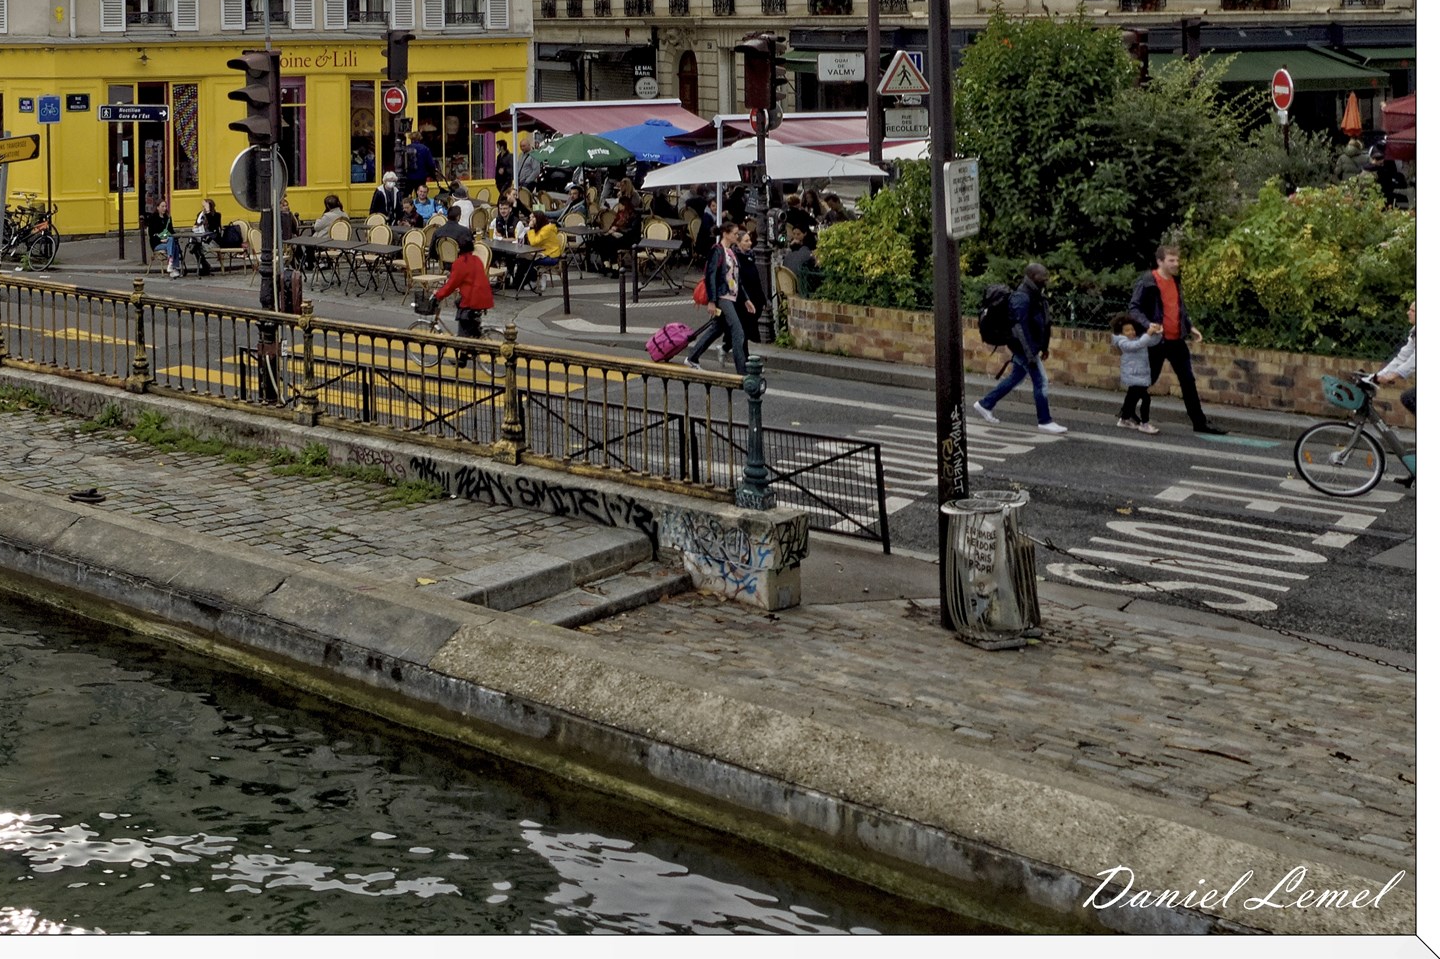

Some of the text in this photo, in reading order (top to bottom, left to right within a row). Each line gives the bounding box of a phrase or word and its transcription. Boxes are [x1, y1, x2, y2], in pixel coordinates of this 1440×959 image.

[280, 49, 358, 68] oine & Lili
